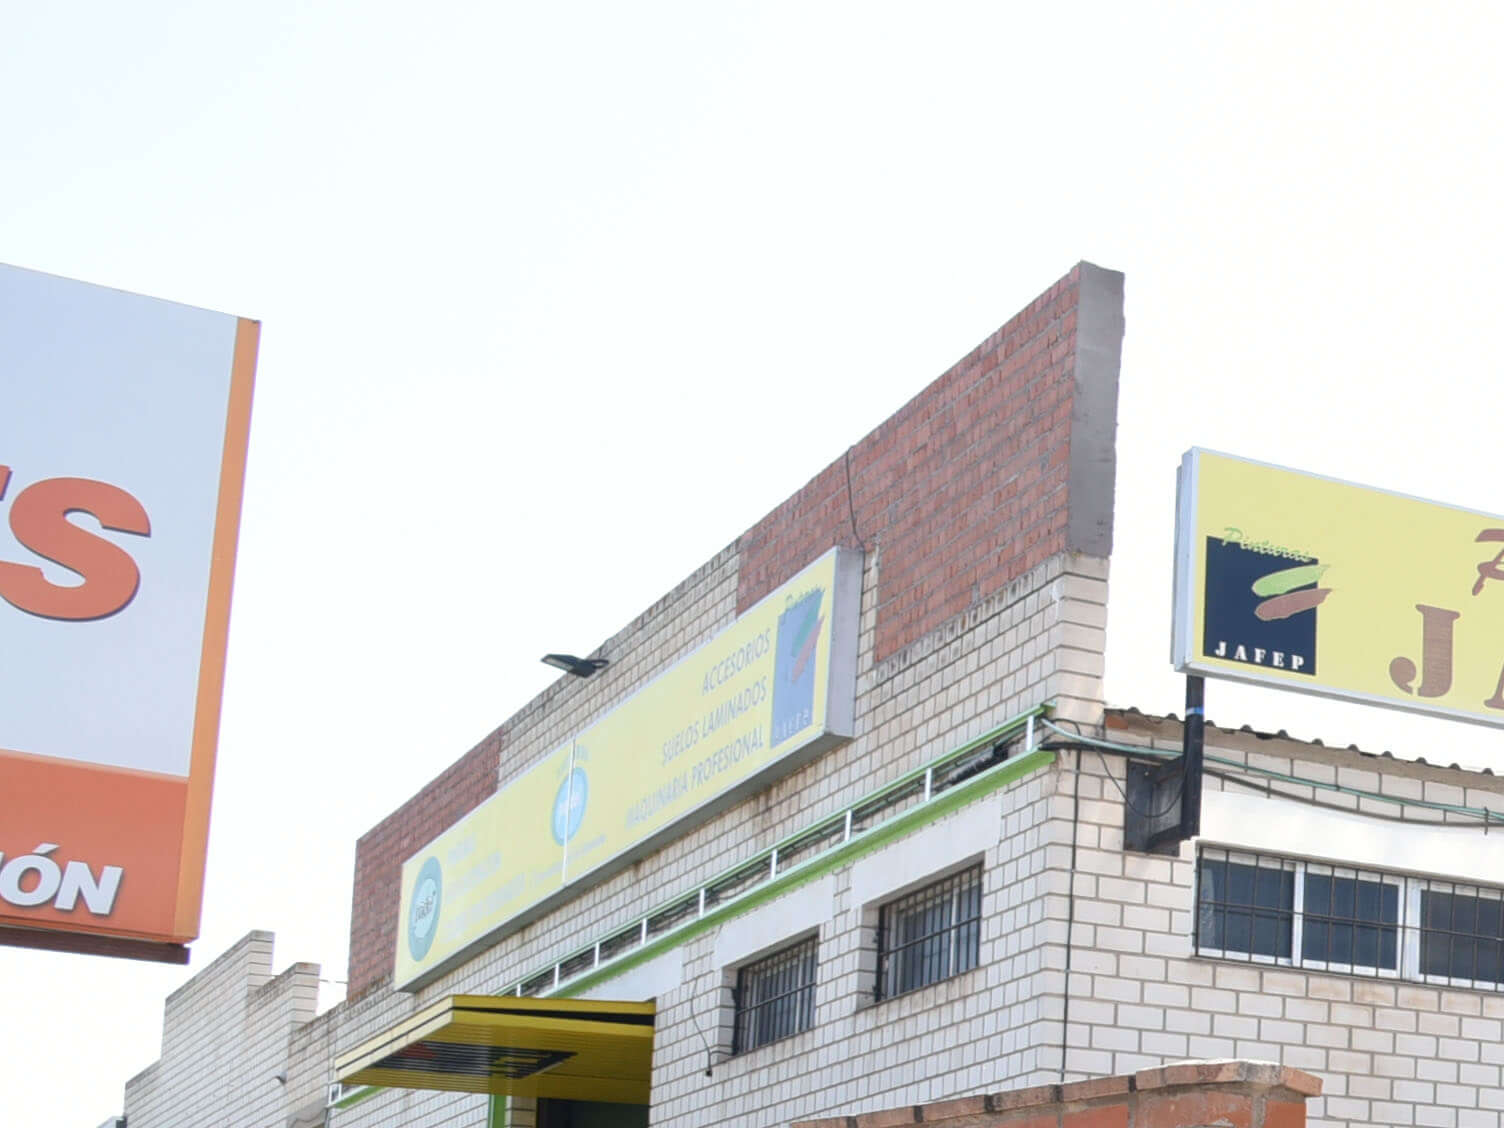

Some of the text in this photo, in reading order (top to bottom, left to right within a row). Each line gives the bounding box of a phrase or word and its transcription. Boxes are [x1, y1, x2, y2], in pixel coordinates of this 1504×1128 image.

[0, 465, 151, 622] S
[1222, 527, 1313, 562] Pinturas
[702, 628, 771, 696] ACCESORIOS
[1214, 641, 1304, 670] JAFEP
[661, 721, 700, 767] SUELOS
[702, 676, 767, 740] LAMINADOS
[691, 726, 764, 790] PROFESIONAL
[0, 843, 123, 916] ÓN
